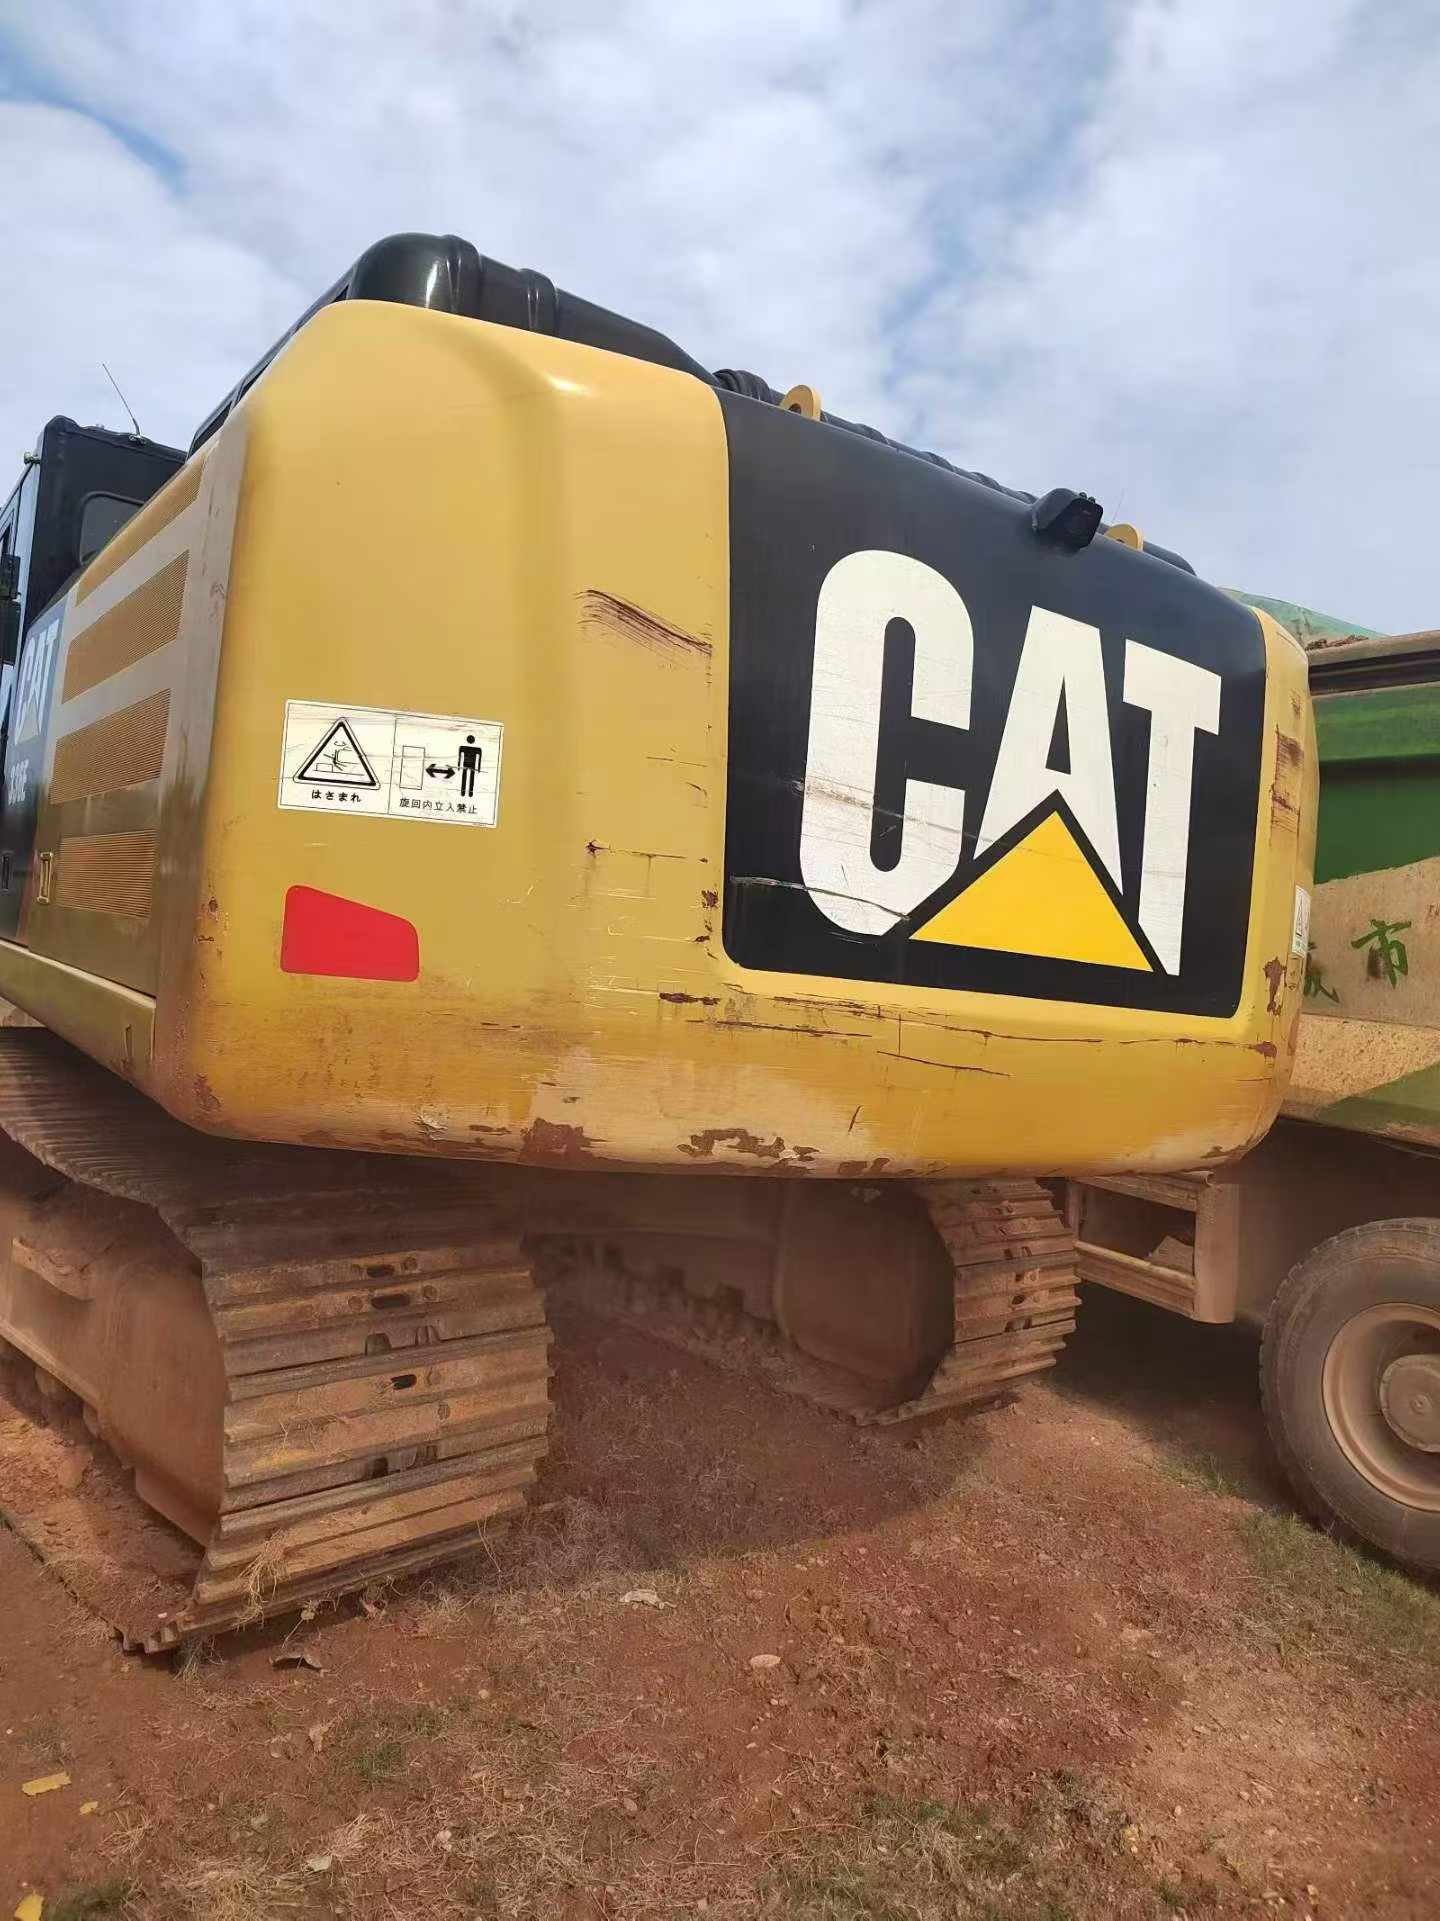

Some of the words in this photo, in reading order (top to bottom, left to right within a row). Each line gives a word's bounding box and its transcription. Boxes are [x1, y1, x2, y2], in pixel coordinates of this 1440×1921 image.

[14, 617, 60, 746] CAT
[311, 789, 362, 803] はさまれ
[800, 549, 1222, 976] CAT
[399, 797, 478, 815] 旋回内立入禁止
